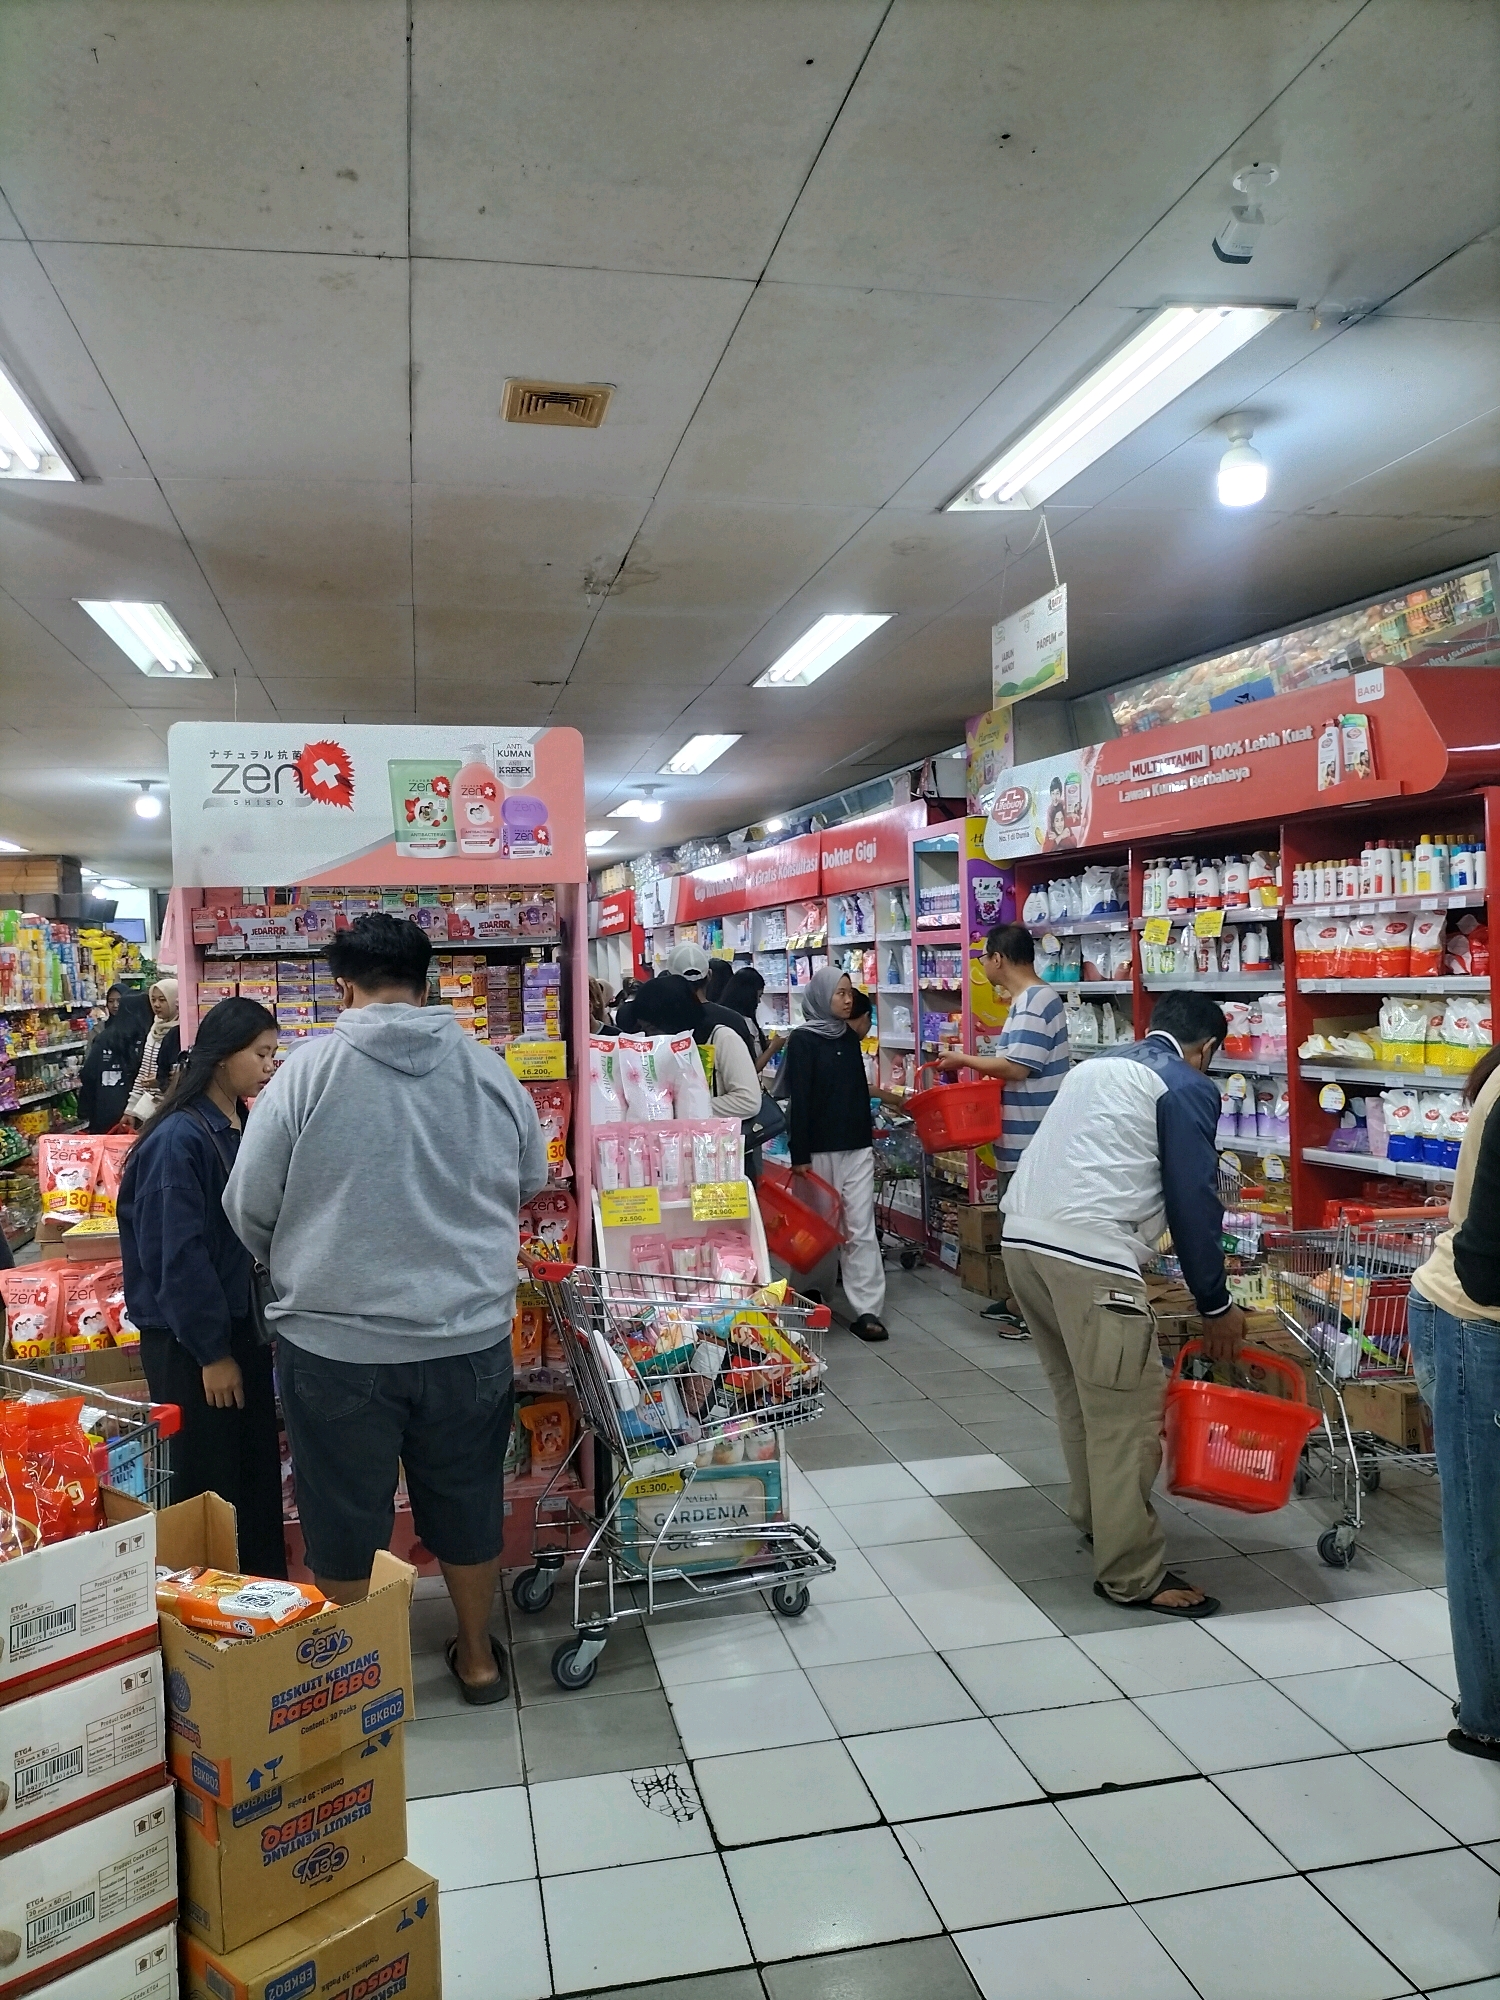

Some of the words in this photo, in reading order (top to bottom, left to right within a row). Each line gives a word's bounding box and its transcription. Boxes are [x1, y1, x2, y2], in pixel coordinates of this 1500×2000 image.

[1036, 631, 1057, 651] PARFUM
[1357, 683, 1382, 697] BARU
[497, 750, 532, 758] KUMAN
[1096, 769, 1131, 786] Dengan
[1131, 750, 1203, 777] MULTIVITAMIN
[1211, 740, 1243, 760] 100%
[1245, 732, 1281, 752] Lebih
[1282, 726, 1313, 745] Kuat
[211, 763, 304, 794] zen
[408, 781, 434, 792] zen
[1119, 785, 1151, 802] Lawan
[1151, 778, 1187, 797] Kuman
[1190, 765, 1250, 789] Berbahaya
[461, 786, 483, 796] zen
[995, 799, 1024, 812] Lifebuoy
[514, 831, 534, 841] zen
[822, 848, 854, 870] Dokter
[855, 837, 877, 864] Gigi
[756, 869, 777, 887] Gratis
[778, 852, 818, 879] Konsultasi
[250, 926, 287, 936] JEDARRR
[478, 920, 511, 930] JEDARRR
[534, 1101, 548, 1110] en
[50, 1150, 79, 1161] zen
[549, 1145, 565, 1159] 30
[69, 1192, 88, 1207] 30
[531, 1201, 556, 1211] zen
[8, 1292, 37, 1305] zen
[635, 1482, 674, 1495] 15.300,-
[654, 1504, 749, 1527] GARDENIA
[10, 1603, 28, 1613] ETG4
[296, 1628, 353, 1669] Gery
[271, 1675, 323, 1708] BISKUIT
[325, 1650, 380, 1681] KENTANG
[268, 1687, 330, 1734] Rasa
[330, 1662, 382, 1705] BBQ
[100, 1716, 119, 1727] Product
[119, 1711, 132, 1720] Code
[300, 1718, 325, 1735] Content
[329, 1712, 338, 1722] 30
[338, 1704, 357, 1718] Packs
[364, 1700, 403, 1728] EBKBQ2
[15, 1746, 32, 1758] ETG4
[193, 1766, 219, 1791] EBKBQ2
[320, 1777, 345, 1794] Content
[287, 1796, 306, 1809] Packs
[307, 1792, 316, 1801] 30
[316, 1779, 374, 1825] Rasa
[323, 1802, 372, 1837] BISKUIT
[261, 1807, 316, 1853] BBQ
[262, 1828, 320, 1867] KENTANG
[113, 1859, 132, 1872] Product
[133, 1853, 145, 1863] Code
[292, 1841, 349, 1885] Gery
[26, 1896, 44, 1910] ETG4
[355, 1954, 380, 1973] Content
[268, 1967, 313, 2000] EBKBQ2
[321, 1976, 341, 1992] Packs
[342, 1973, 351, 1982] 30
[351, 1952, 410, 2000] Rasa
